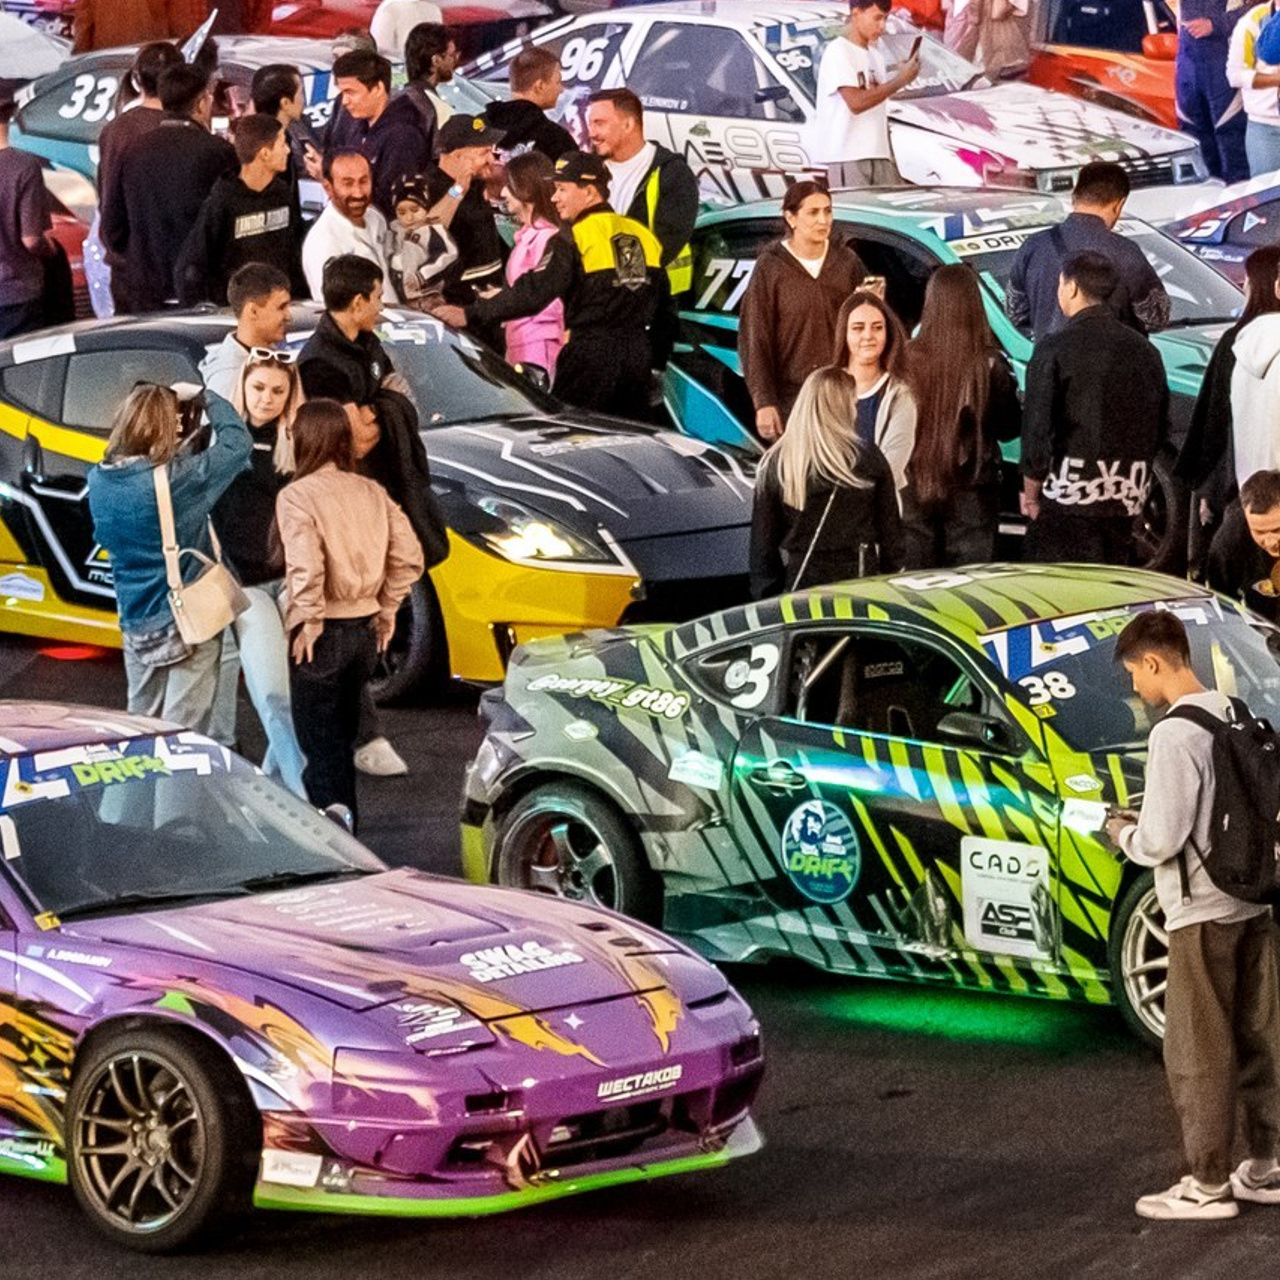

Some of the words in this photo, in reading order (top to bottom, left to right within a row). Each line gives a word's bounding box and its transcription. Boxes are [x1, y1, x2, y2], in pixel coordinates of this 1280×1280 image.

[561, 37, 609, 82] 96
[775, 49, 812, 71] 96
[58, 73, 116, 122] 33
[695, 259, 757, 311] 77
[1018, 671, 1076, 705] 38
[459, 941, 553, 970] SWAG
[468, 951, 586, 983] DETAILING
